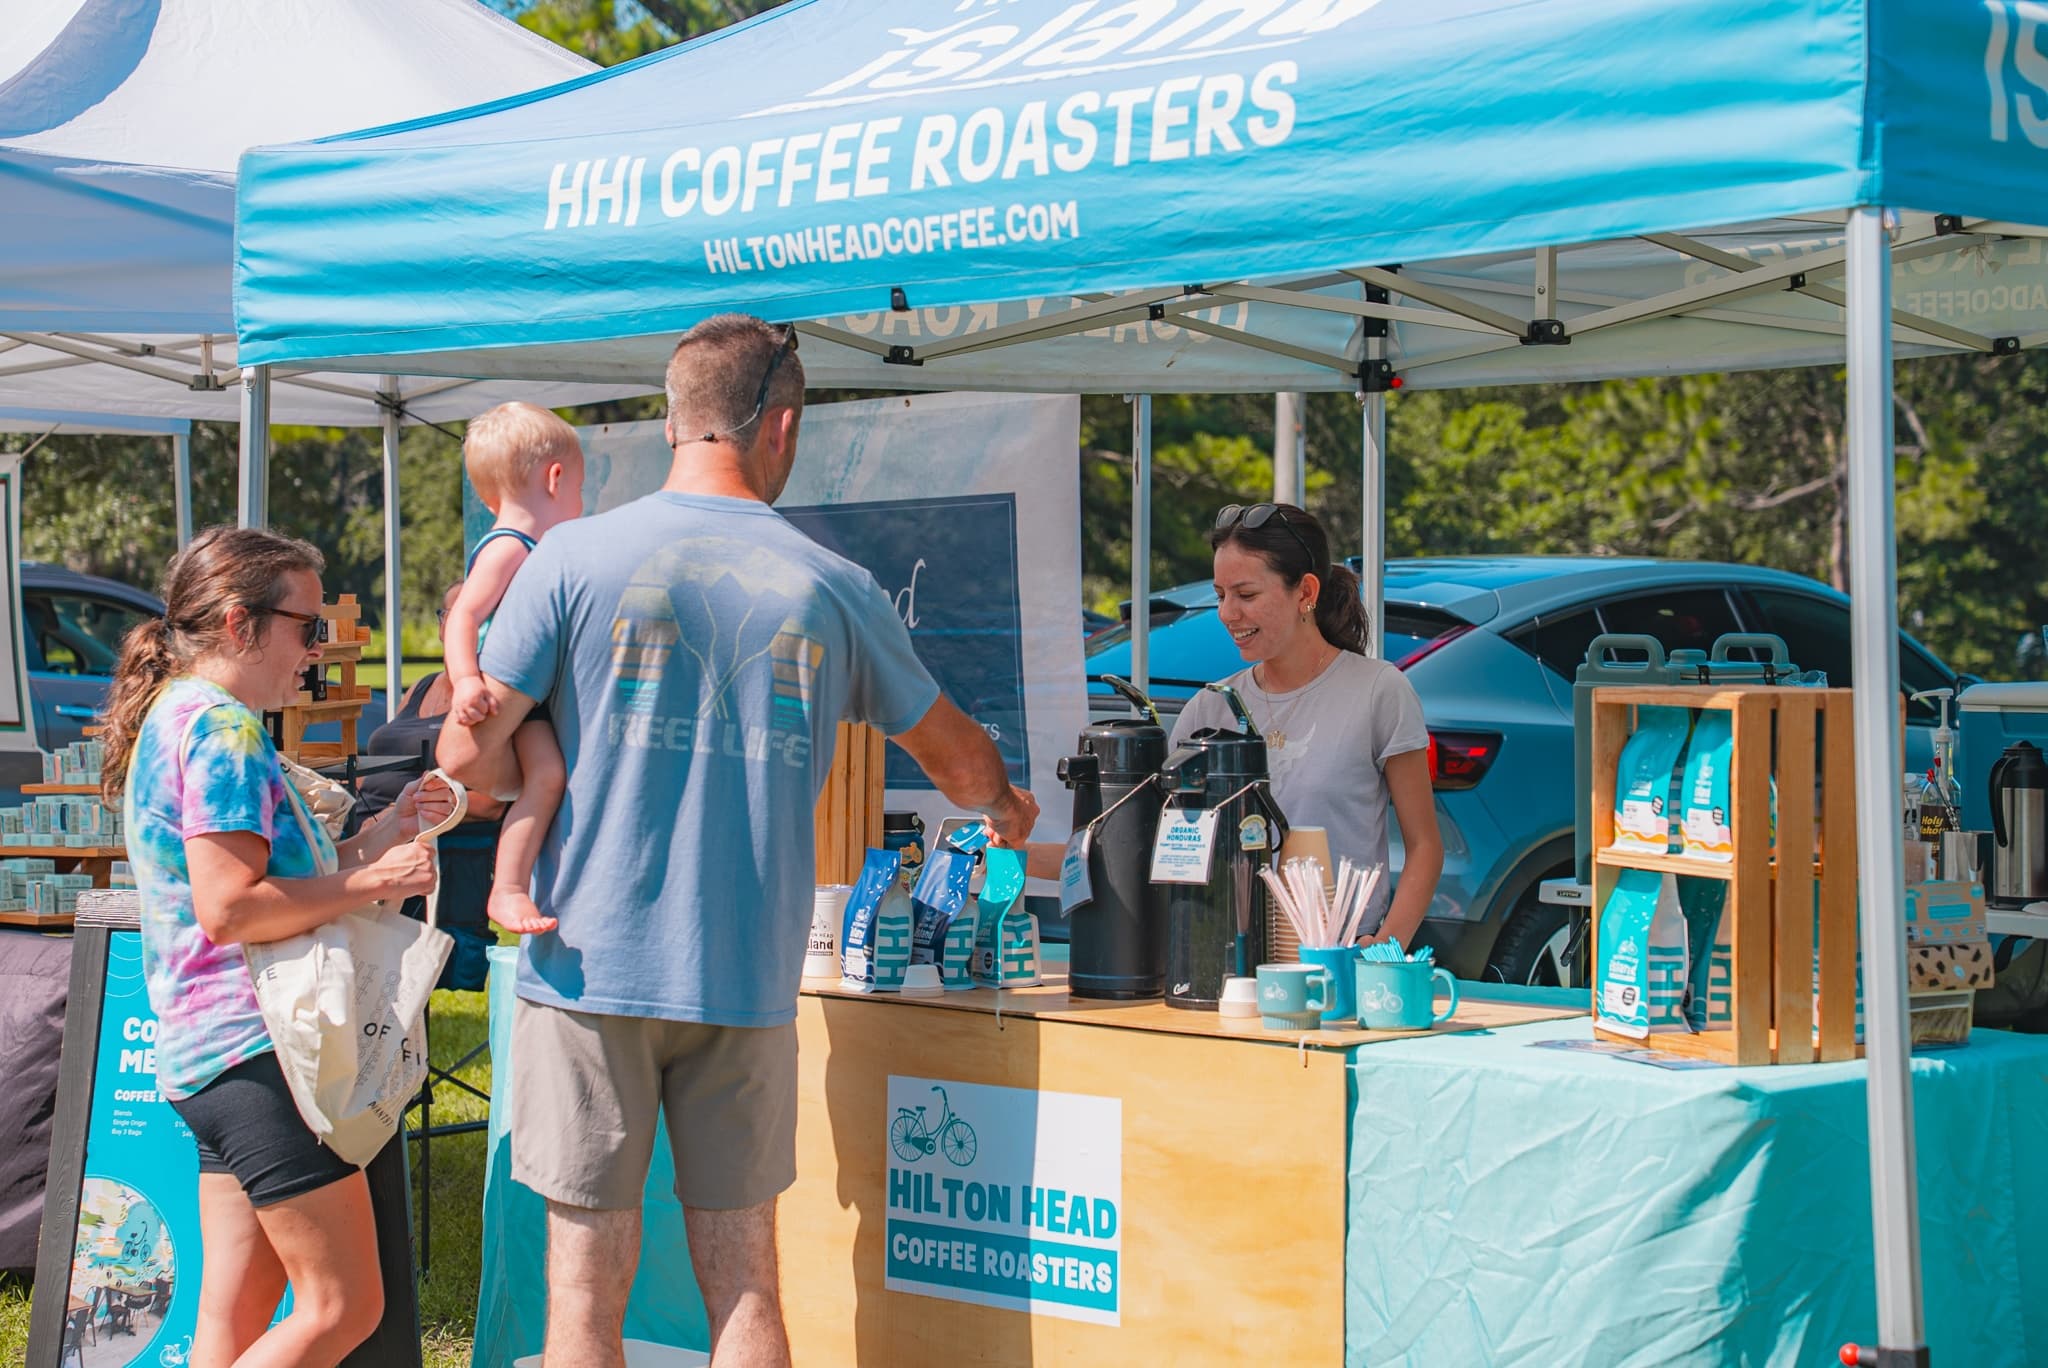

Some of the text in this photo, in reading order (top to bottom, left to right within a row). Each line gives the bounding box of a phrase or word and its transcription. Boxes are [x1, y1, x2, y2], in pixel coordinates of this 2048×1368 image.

[544, 60, 1299, 230] HHI COFFEE ROASTERS
[703, 200, 1080, 275] HILTONHEADCOFFEE.COM
[608, 713, 811, 769] REEL LIFE
[1166, 834, 1202, 842] HONDURAS
[1170, 826, 1200, 834] ORGANIC
[114, 1089, 157, 1103] COFFEE
[889, 1168, 1118, 1240] HILTON HEAD
[892, 1233, 1113, 1294] COFFEE ROASTERS
